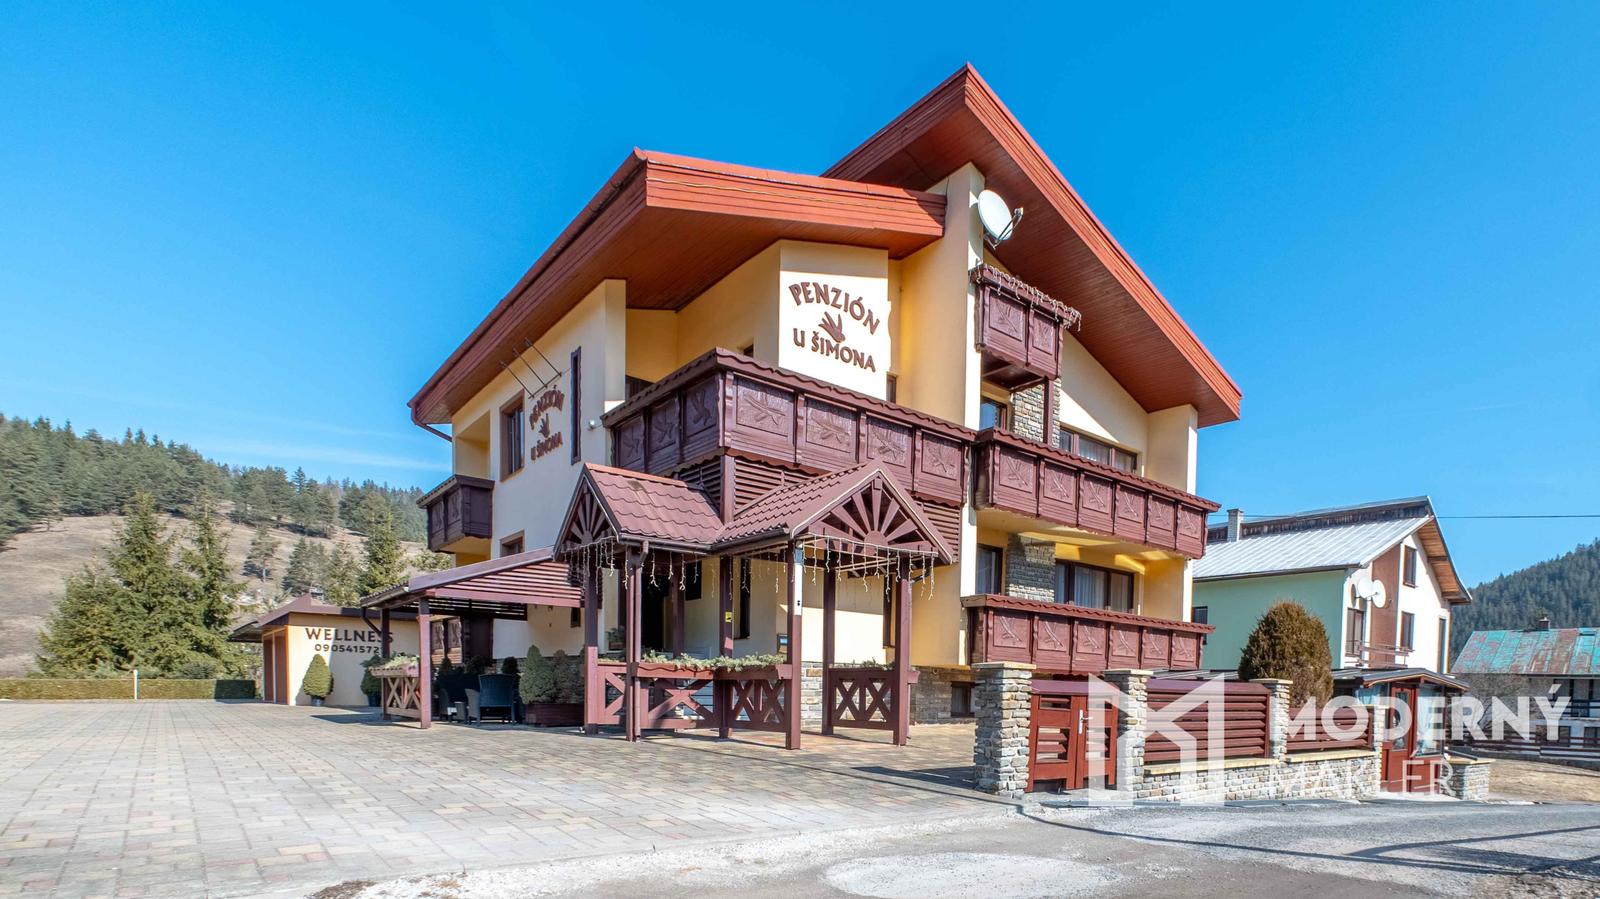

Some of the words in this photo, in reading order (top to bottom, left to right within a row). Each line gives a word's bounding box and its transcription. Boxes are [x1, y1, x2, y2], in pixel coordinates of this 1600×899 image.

[789, 281, 880, 335] PENZIÓN
[793, 327, 805, 348] U
[811, 330, 876, 373] ŠIMONA
[305, 627, 394, 643] WELLNES
[314, 643, 383, 653] 090541572
